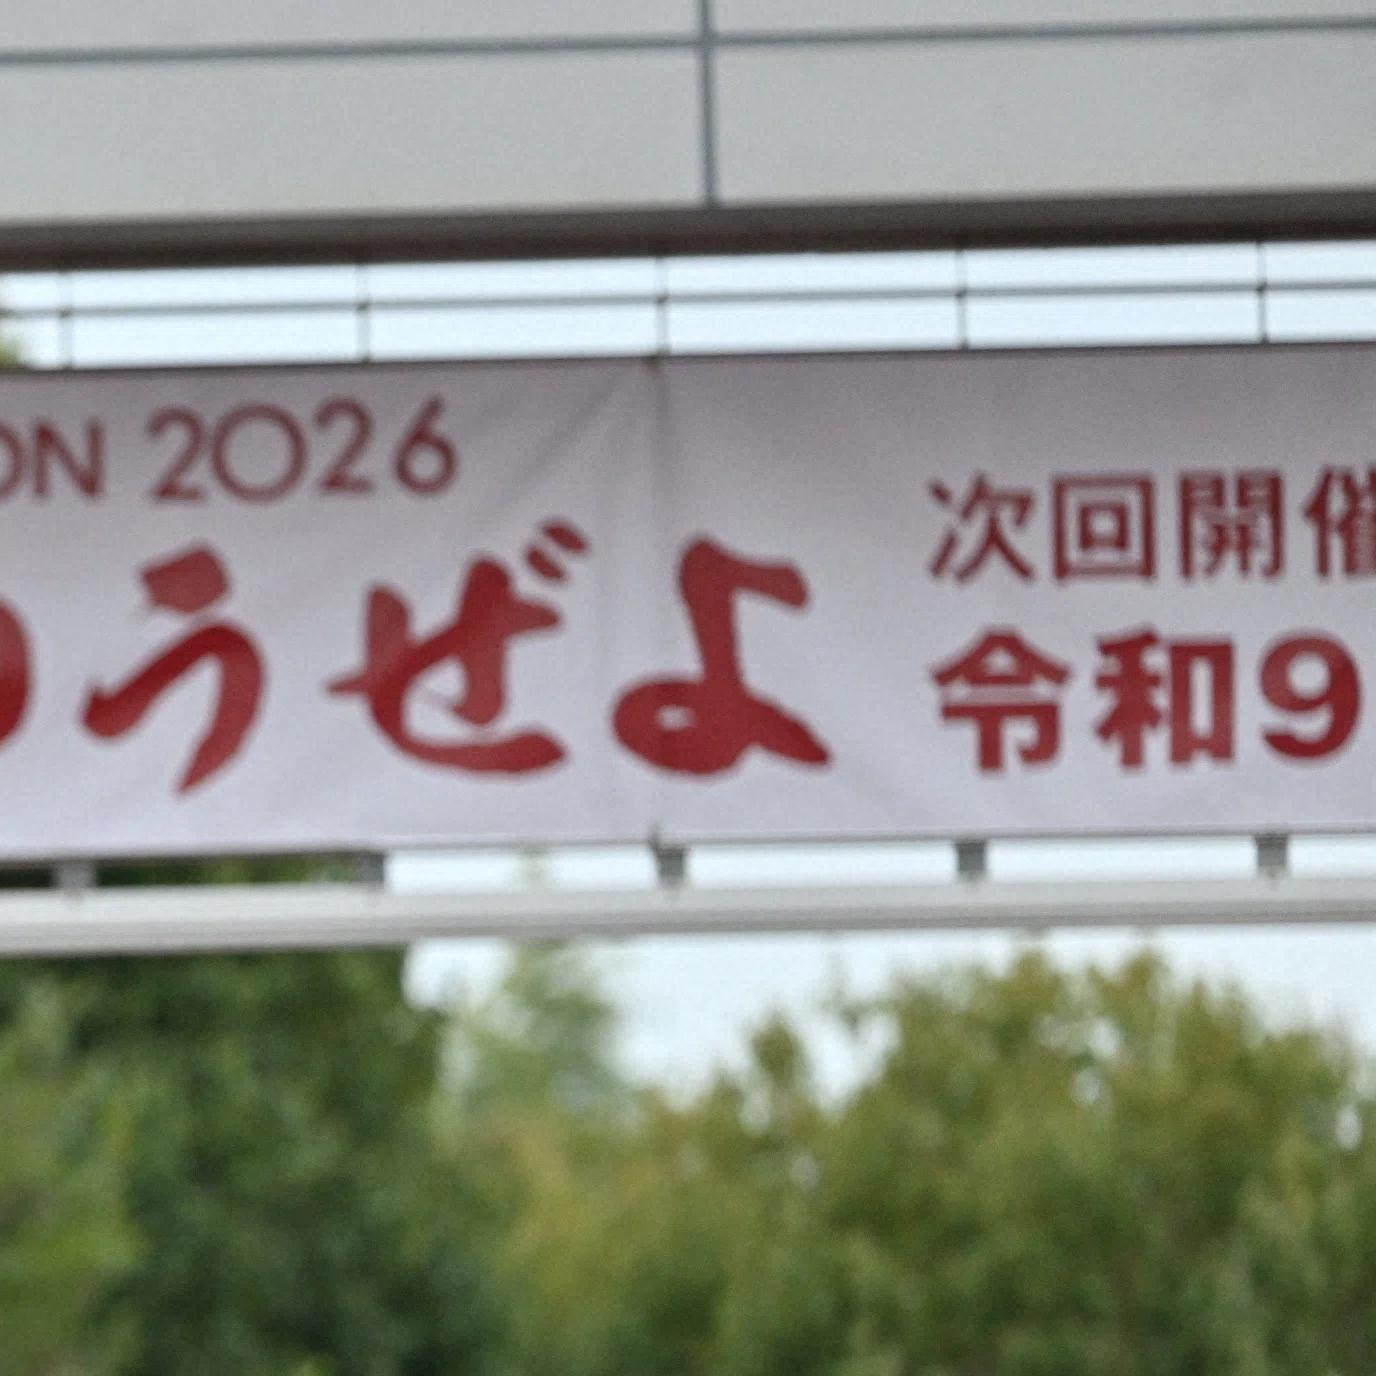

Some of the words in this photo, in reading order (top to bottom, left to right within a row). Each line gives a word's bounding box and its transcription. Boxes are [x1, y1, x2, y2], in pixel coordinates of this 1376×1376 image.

[150, 398, 459, 501] 2026
[929, 468, 1376, 580] 次回開催
[930, 625, 1362, 774] 令和9
